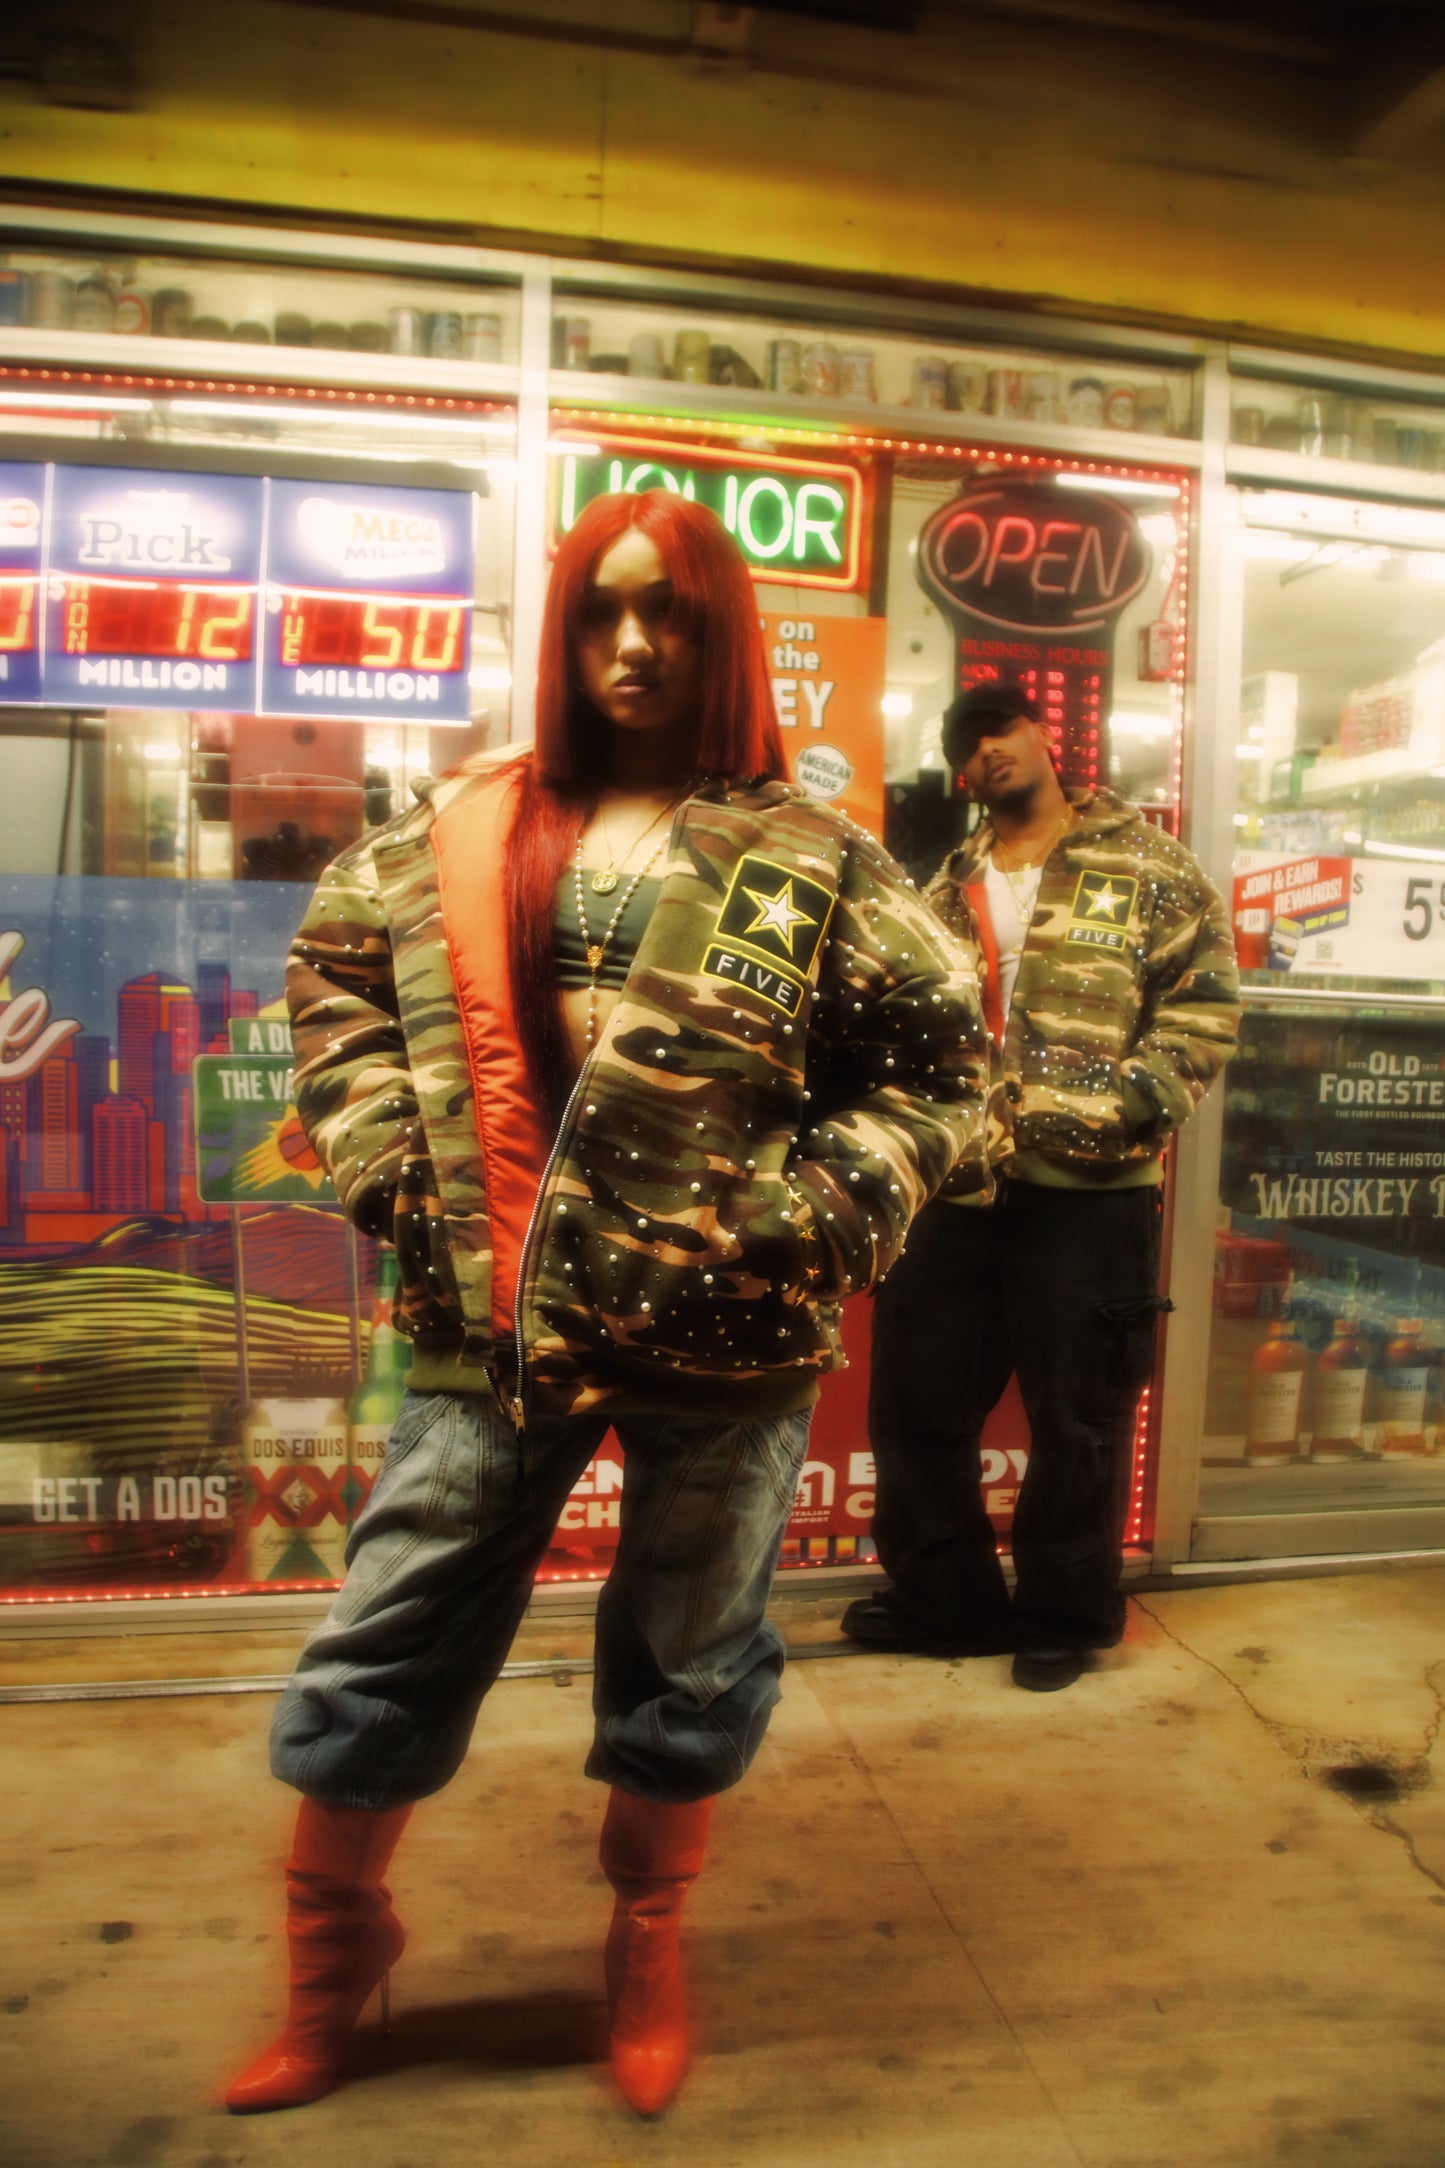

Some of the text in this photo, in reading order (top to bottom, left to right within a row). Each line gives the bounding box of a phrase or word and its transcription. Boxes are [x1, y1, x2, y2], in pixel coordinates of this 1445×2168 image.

[84, 519, 214, 565] Pick
[936, 512, 1129, 598] OPEN
[176, 588, 252, 660] 12
[778, 620, 815, 641] on
[772, 643, 820, 670] the
[961, 639, 1108, 667] BUSINESS HOURS
[79, 658, 227, 690] MILLION
[296, 669, 439, 699] MILLION
[799, 751, 855, 780] AMERICAN
[801, 768, 839, 792] MADE
[1241, 859, 1319, 900] JOIN & EARN
[1352, 872, 1364, 895] $
[1274, 877, 1342, 916] REWARDS!
[1072, 928, 1119, 946] FIVE
[715, 953, 793, 1004] FIVE
[248, 1022, 265, 1053] A
[1369, 1050, 1421, 1076] OLD
[217, 1069, 265, 1100] THE
[1335, 1109, 1350, 1118] THE
[1316, 1151, 1445, 1168] TASTE THE HISTO
[253, 1438, 344, 1459] DOS EQUIS
[33, 1475, 227, 1522] GET A DOS
